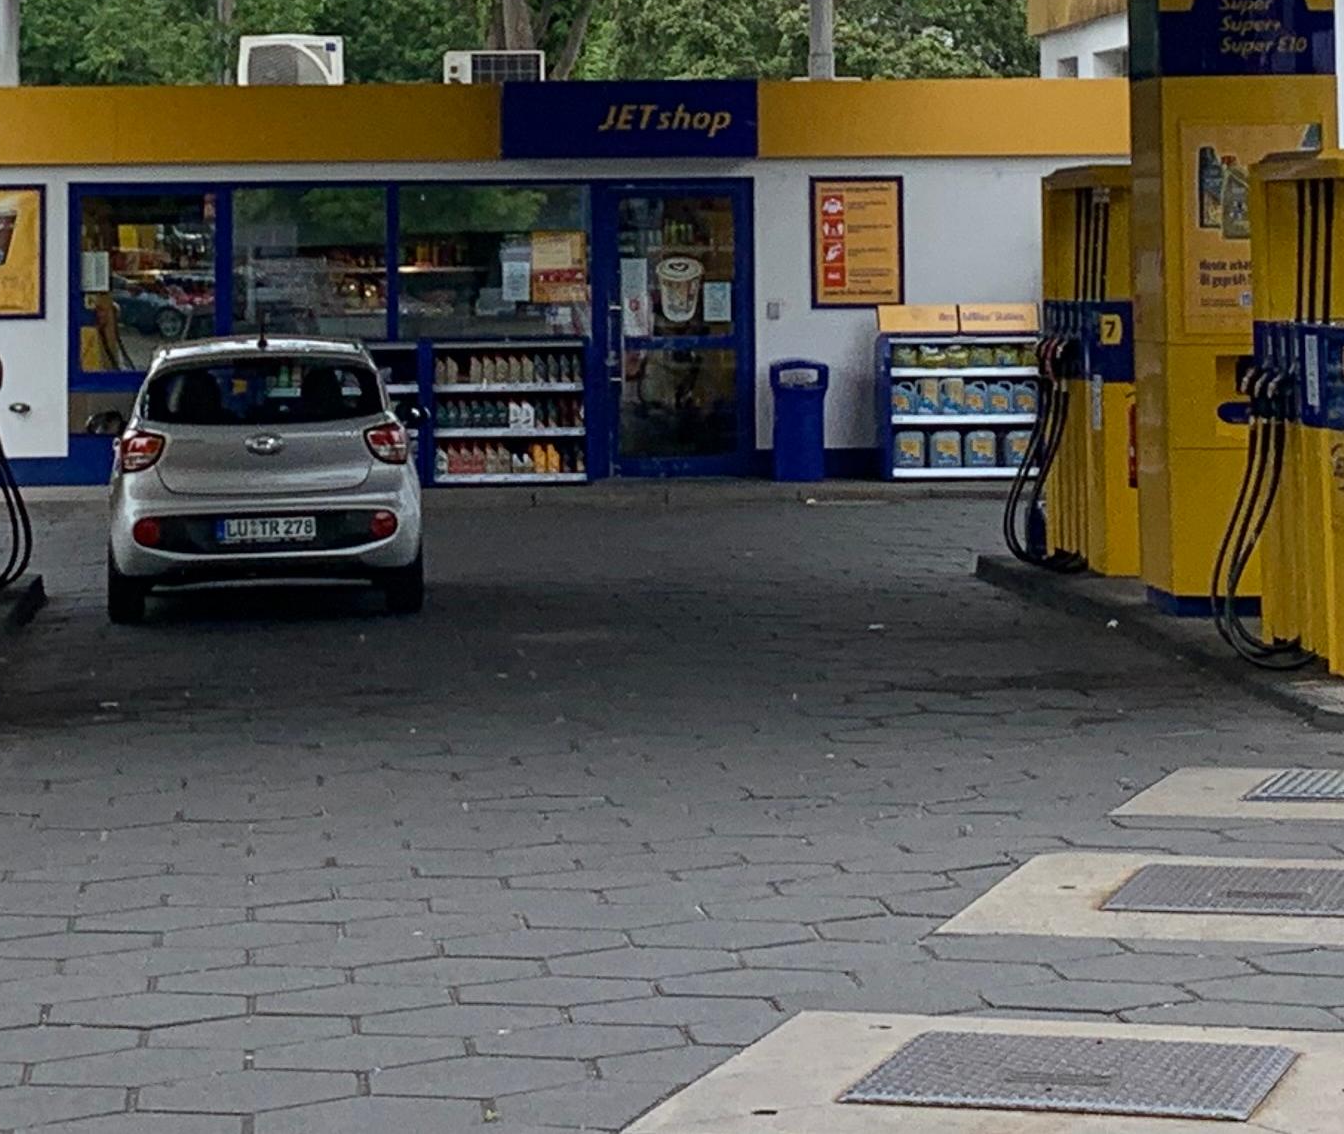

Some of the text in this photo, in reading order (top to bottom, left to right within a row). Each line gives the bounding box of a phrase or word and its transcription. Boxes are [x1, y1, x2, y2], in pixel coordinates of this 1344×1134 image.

[1219, 36, 1307, 57] Super E10
[1104, 321, 1116, 339] 7
[226, 518, 314, 537] LU TR 278
